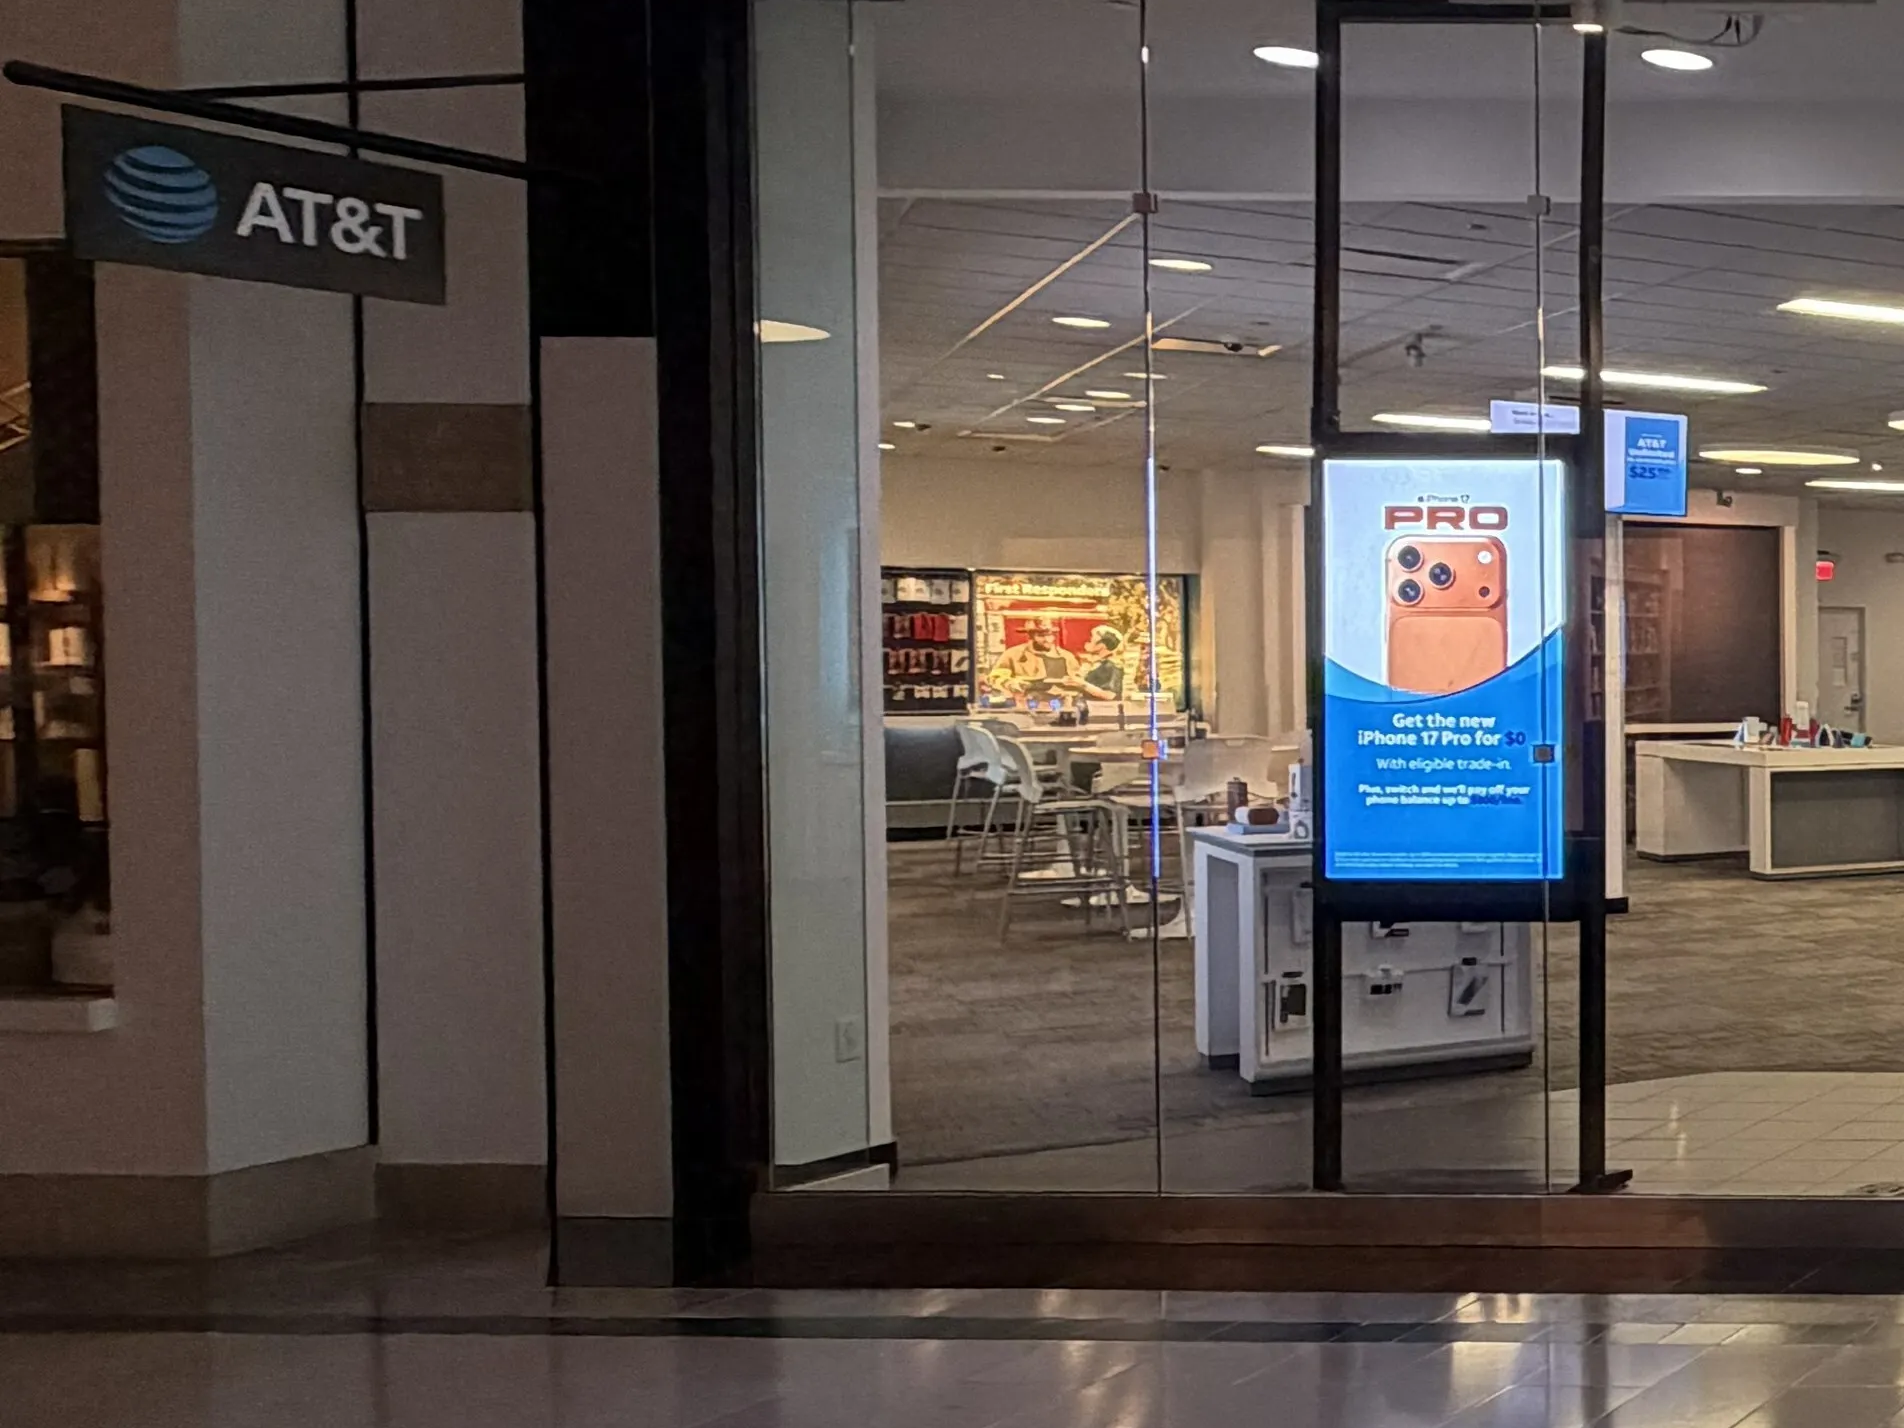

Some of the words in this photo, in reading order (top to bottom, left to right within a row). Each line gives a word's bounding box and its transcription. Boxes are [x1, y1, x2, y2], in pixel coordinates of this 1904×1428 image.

[236, 181, 424, 261] AT&T
[1384, 505, 1508, 531] PRO
[1392, 713, 1424, 729] Get
[1426, 713, 1456, 729] the
[1459, 716, 1496, 729] new
[1357, 730, 1417, 746] iPhone
[1420, 731, 1440, 746] 17
[1441, 731, 1472, 746] Pro
[1474, 730, 1501, 746] for
[1504, 730, 1526, 747] $0
[1376, 757, 1407, 770] With
[1408, 757, 1455, 773] eligible
